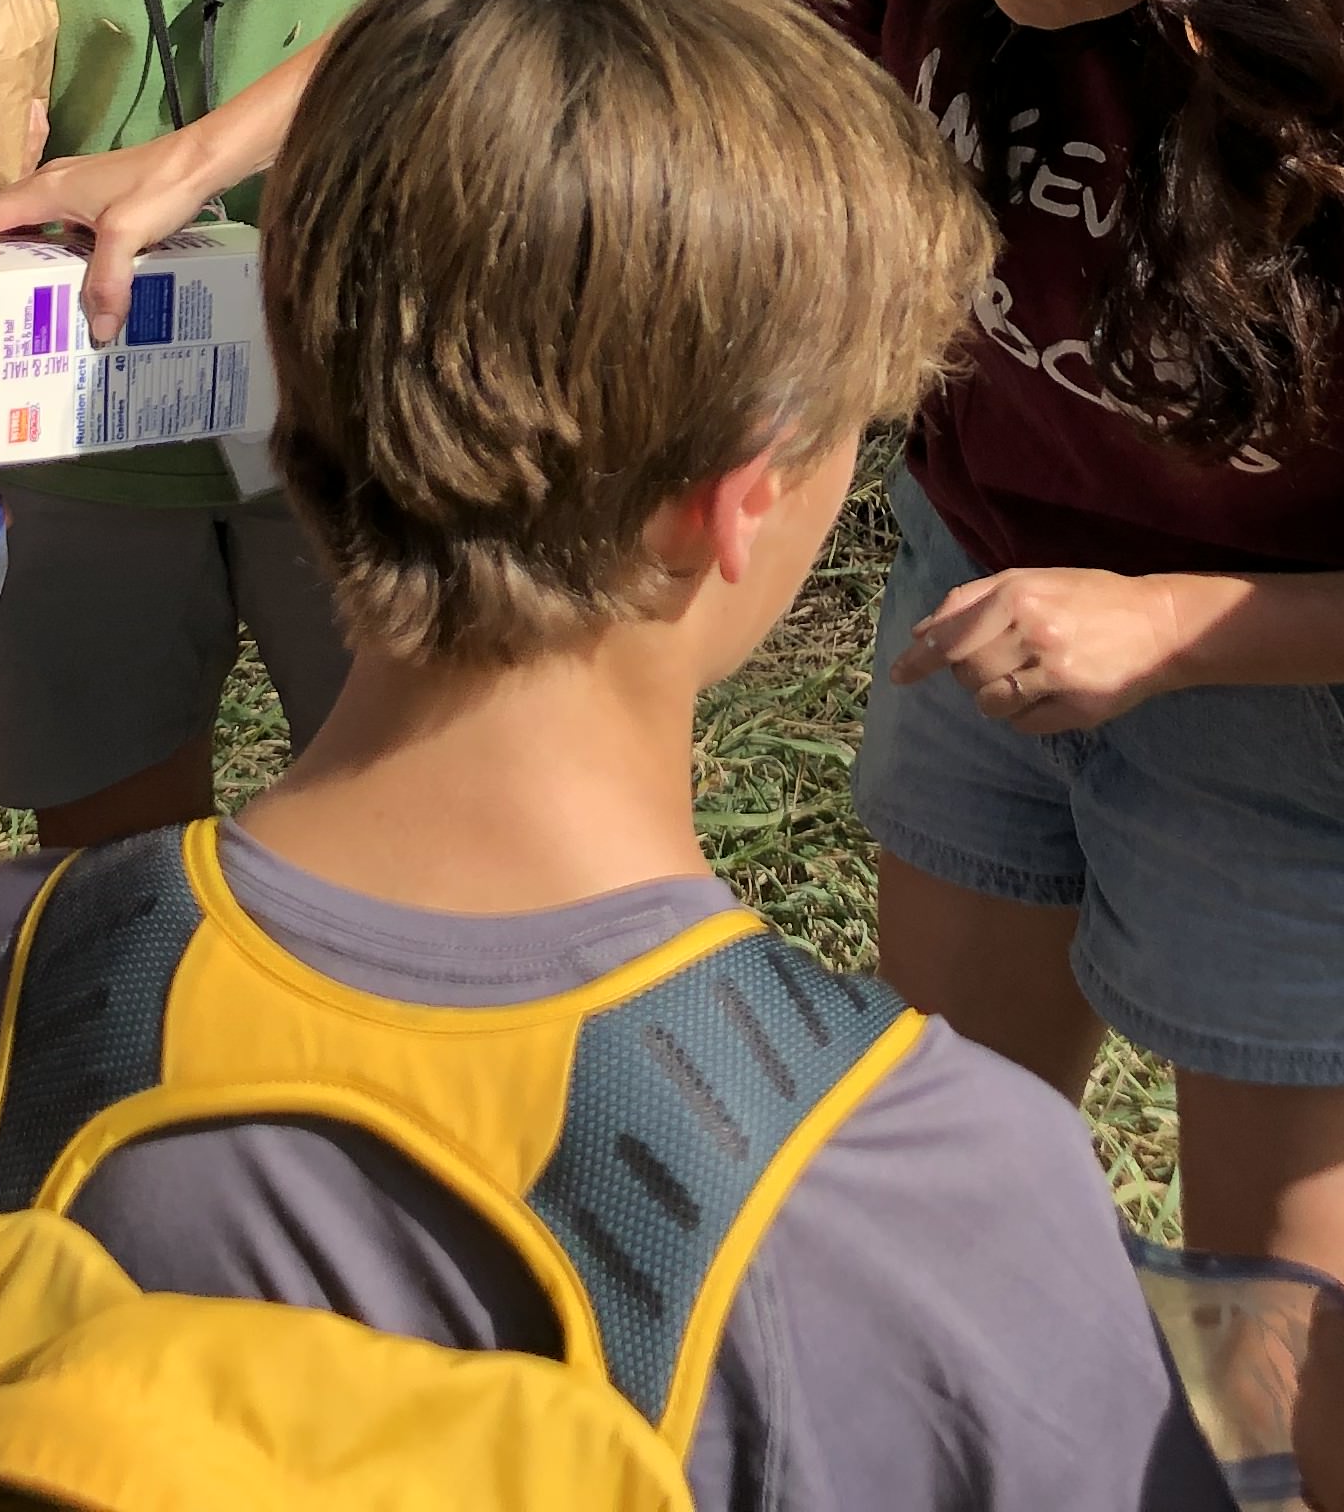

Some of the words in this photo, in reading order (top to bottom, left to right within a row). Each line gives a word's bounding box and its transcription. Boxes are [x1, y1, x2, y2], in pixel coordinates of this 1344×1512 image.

[2, 358, 29, 380] HALF
[33, 359, 42, 377] &
[44, 355, 69, 376] HALF
[75, 358, 87, 391] Facts
[115, 355, 126, 373] 40
[75, 393, 87, 445] Nutrition
[116, 398, 125, 441] Calories
